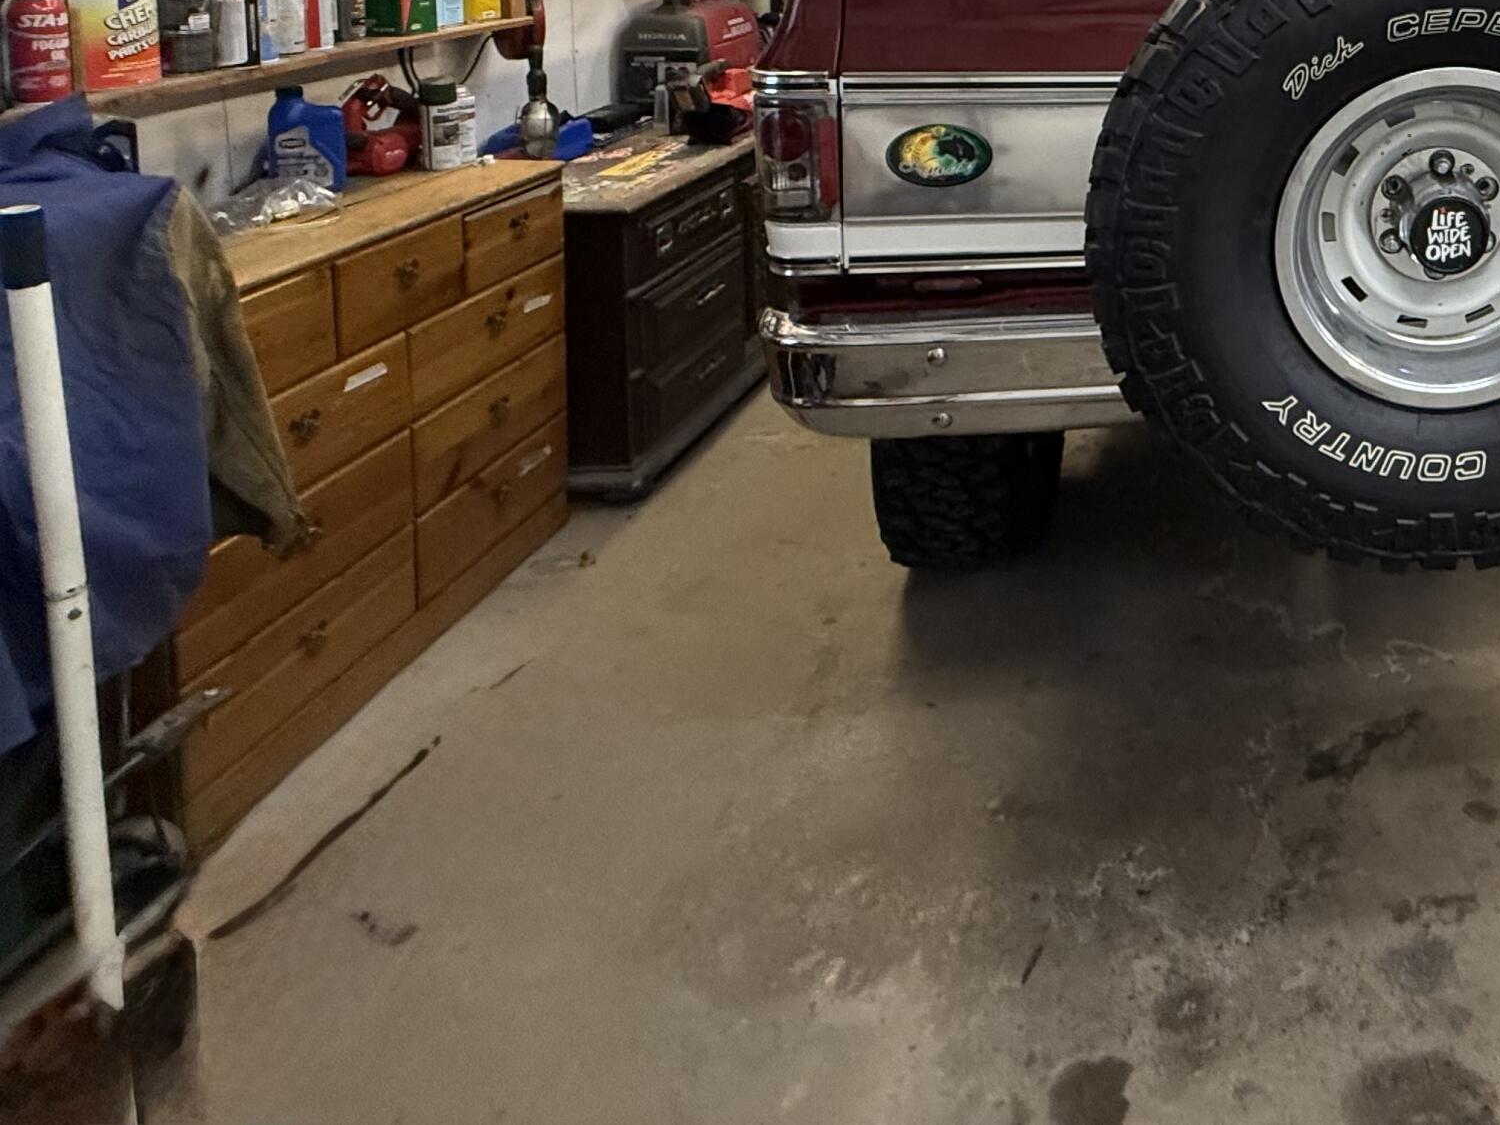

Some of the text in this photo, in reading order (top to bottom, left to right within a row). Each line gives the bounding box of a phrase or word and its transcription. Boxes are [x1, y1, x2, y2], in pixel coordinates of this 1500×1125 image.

[1283, 36, 1364, 100] Dick
[1431, 207, 1469, 230] LIFE
[1427, 226, 1471, 245] WIDE
[1425, 240, 1471, 263] OPEN
[1262, 395, 1488, 483] COUNTRY
